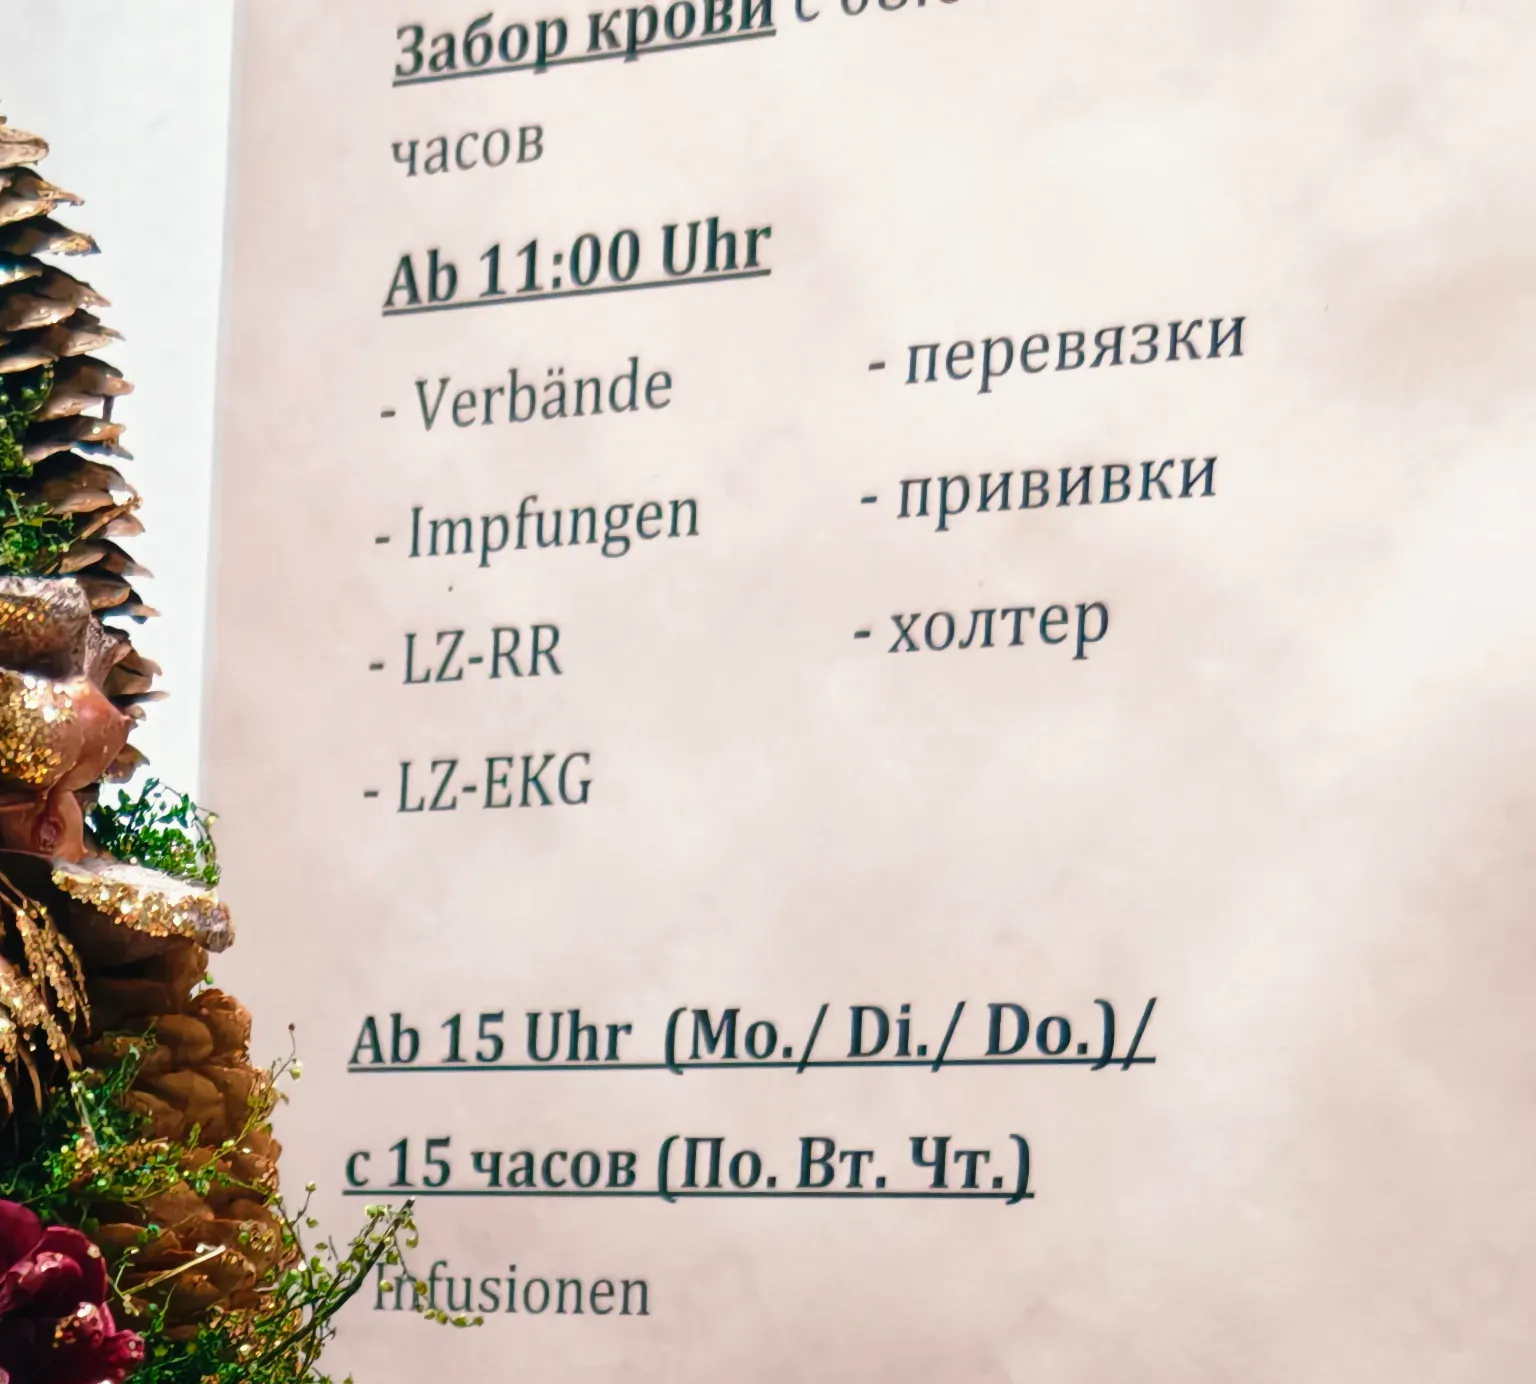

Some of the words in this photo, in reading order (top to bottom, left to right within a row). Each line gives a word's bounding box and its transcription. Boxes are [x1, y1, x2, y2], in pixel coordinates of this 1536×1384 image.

[394, 12, 568, 76] Забор
[585, 0, 775, 61] крови
[390, 121, 545, 178] часов
[384, 247, 459, 308] Ab
[478, 228, 640, 299] 11:00
[663, 217, 771, 279] Uhr
[905, 316, 1247, 395] перевязки
[415, 356, 673, 431] Verbände
[897, 456, 1218, 531] прививки
[408, 494, 700, 568] Impfungen
[403, 624, 563, 685] LZ-RR
[888, 598, 1109, 660] холтер
[397, 752, 592, 813] LZ-EKG
[350, 1015, 419, 1064] Ab
[441, 1013, 504, 1063] 15
[526, 1009, 632, 1063] Uhr
[665, 1003, 830, 1074] (Mo./
[847, 1001, 966, 1072] Di./
[986, 998, 1157, 1071] Do.)/
[346, 1151, 371, 1187] с
[388, 1137, 451, 1188] 15
[471, 1150, 636, 1189] часов
[657, 1135, 777, 1203] (По.
[798, 1137, 887, 1189] Вт.
[910, 1133, 1031, 1204] Чт.)
[373, 1260, 650, 1316] Infusionen
